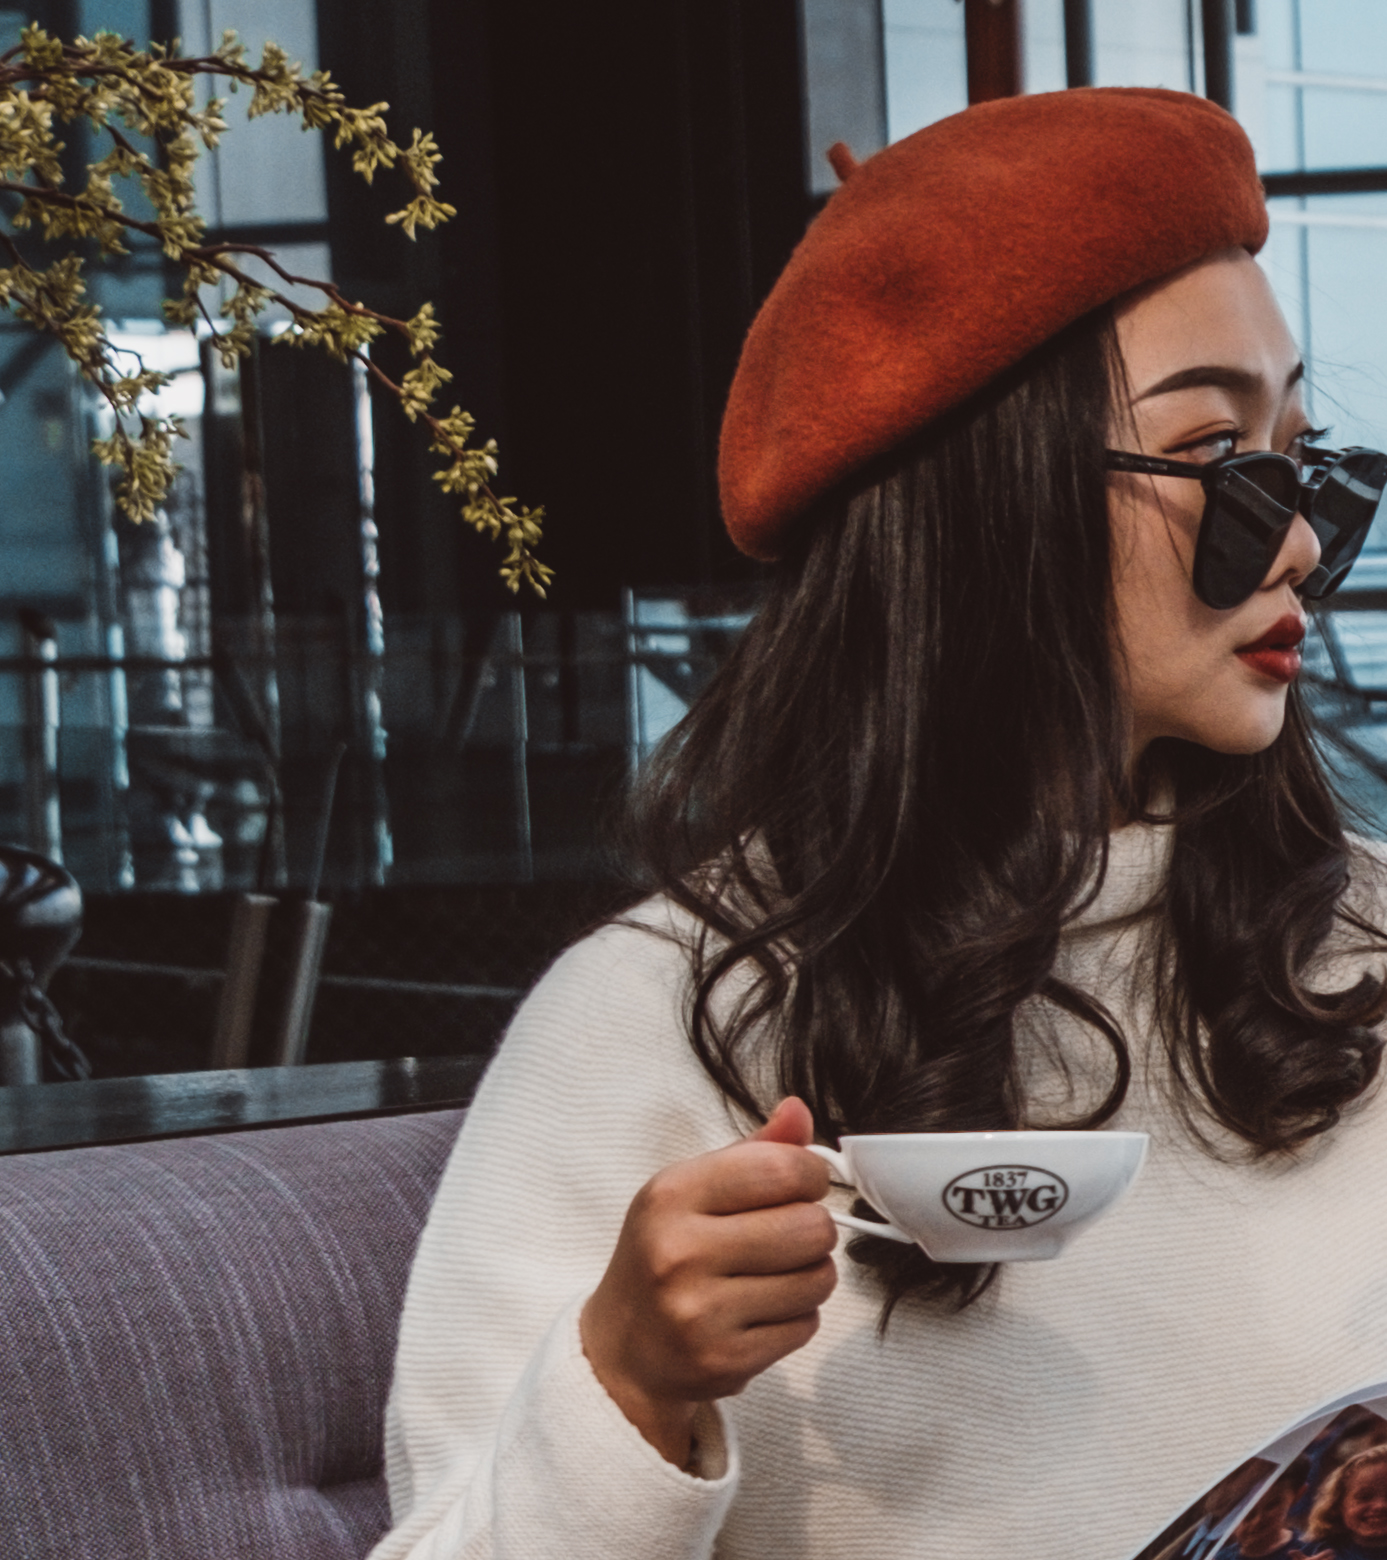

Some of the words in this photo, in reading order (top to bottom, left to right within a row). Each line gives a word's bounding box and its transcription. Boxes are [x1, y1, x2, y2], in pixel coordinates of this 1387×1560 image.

[983, 1171, 1028, 1188] 1837
[952, 1185, 1059, 1215] TWG
[978, 1214, 1030, 1227] TEA
